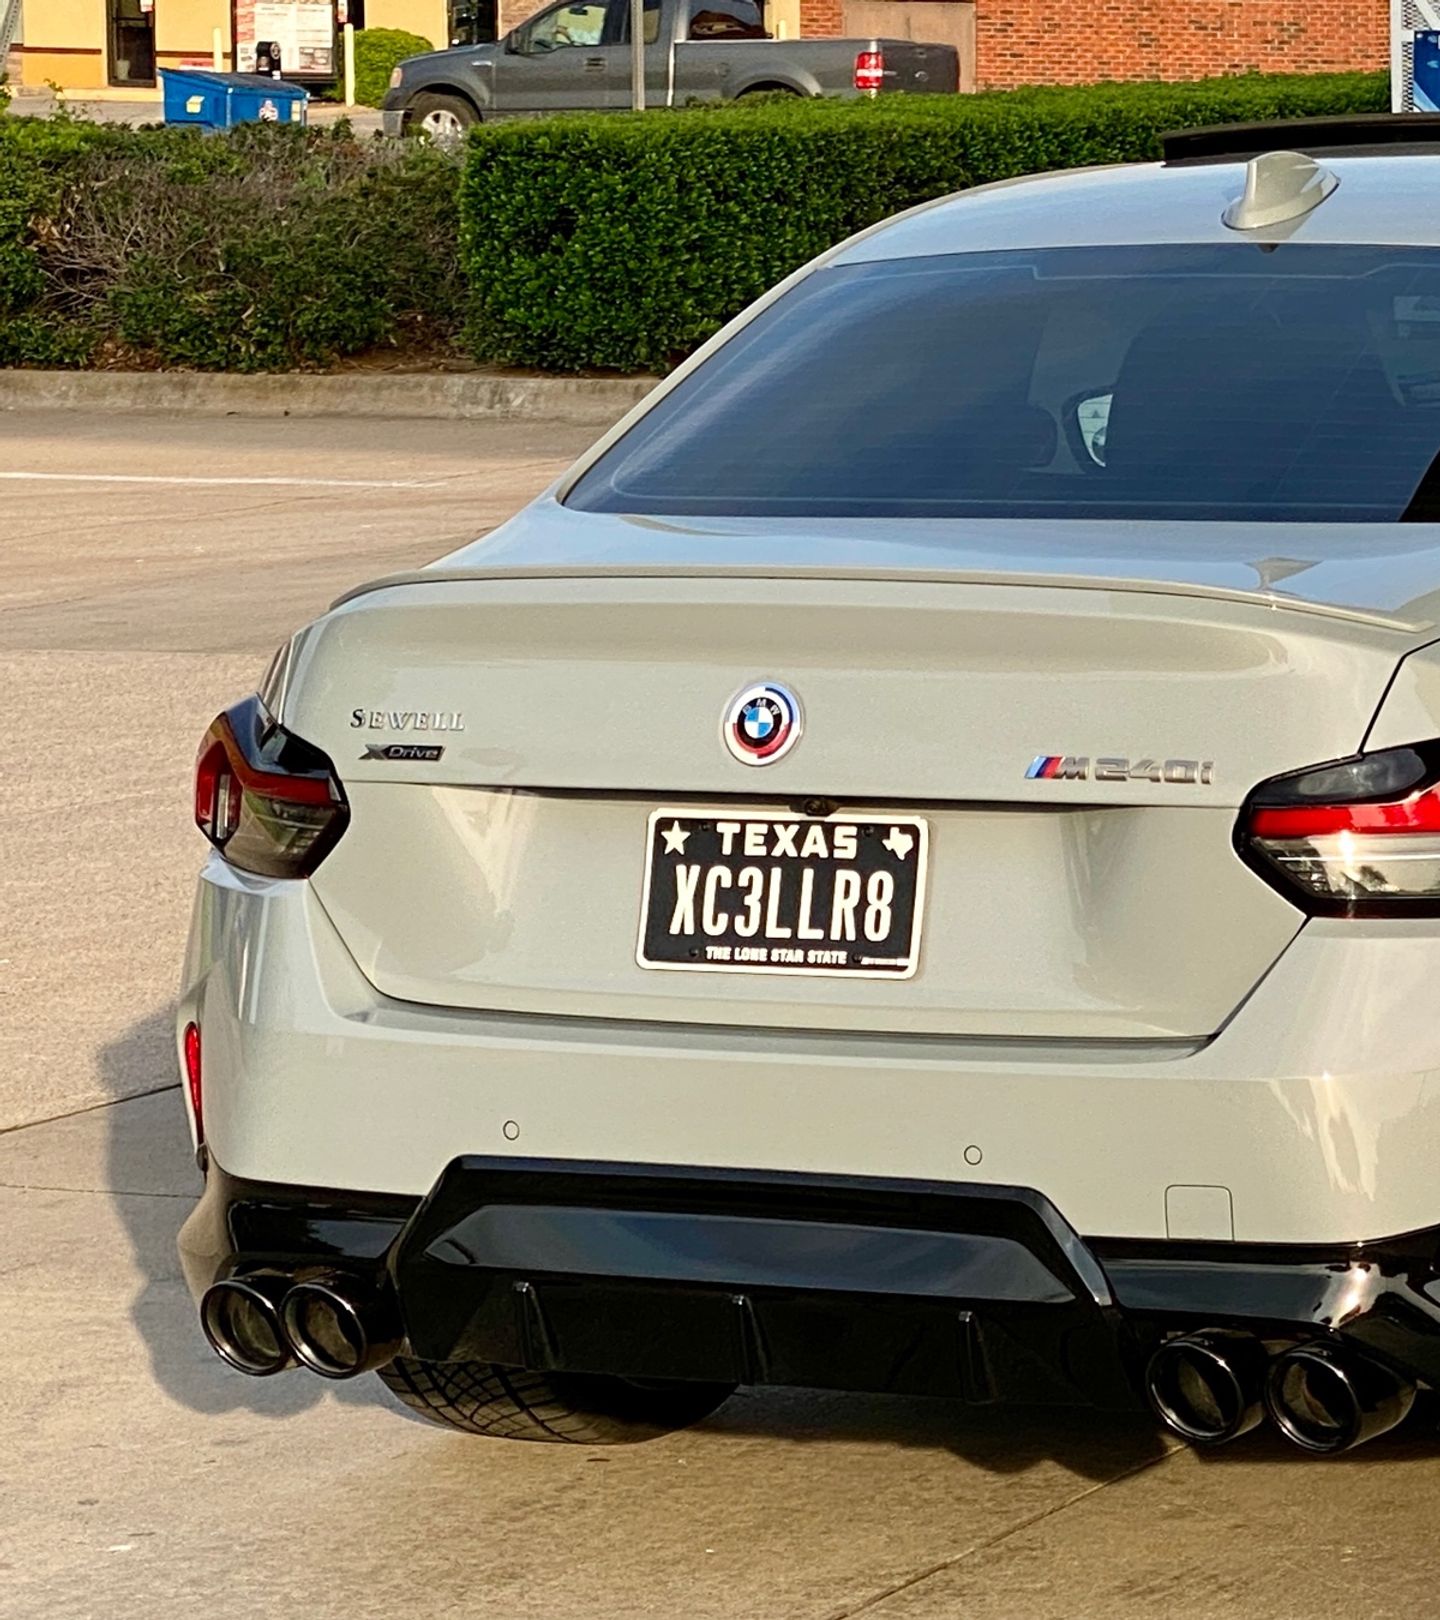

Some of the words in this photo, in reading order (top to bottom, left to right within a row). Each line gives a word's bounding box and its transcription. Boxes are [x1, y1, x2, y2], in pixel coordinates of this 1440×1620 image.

[743, 698, 781, 716] BMW
[350, 708, 466, 731] SEWELL
[716, 822, 859, 859] TEXAS
[668, 863, 895, 943] XC3LLR8
[705, 946, 731, 961] THE
[734, 947, 768, 962] LONE
[771, 948, 805, 963] STAR
[807, 949, 849, 965] STATE
